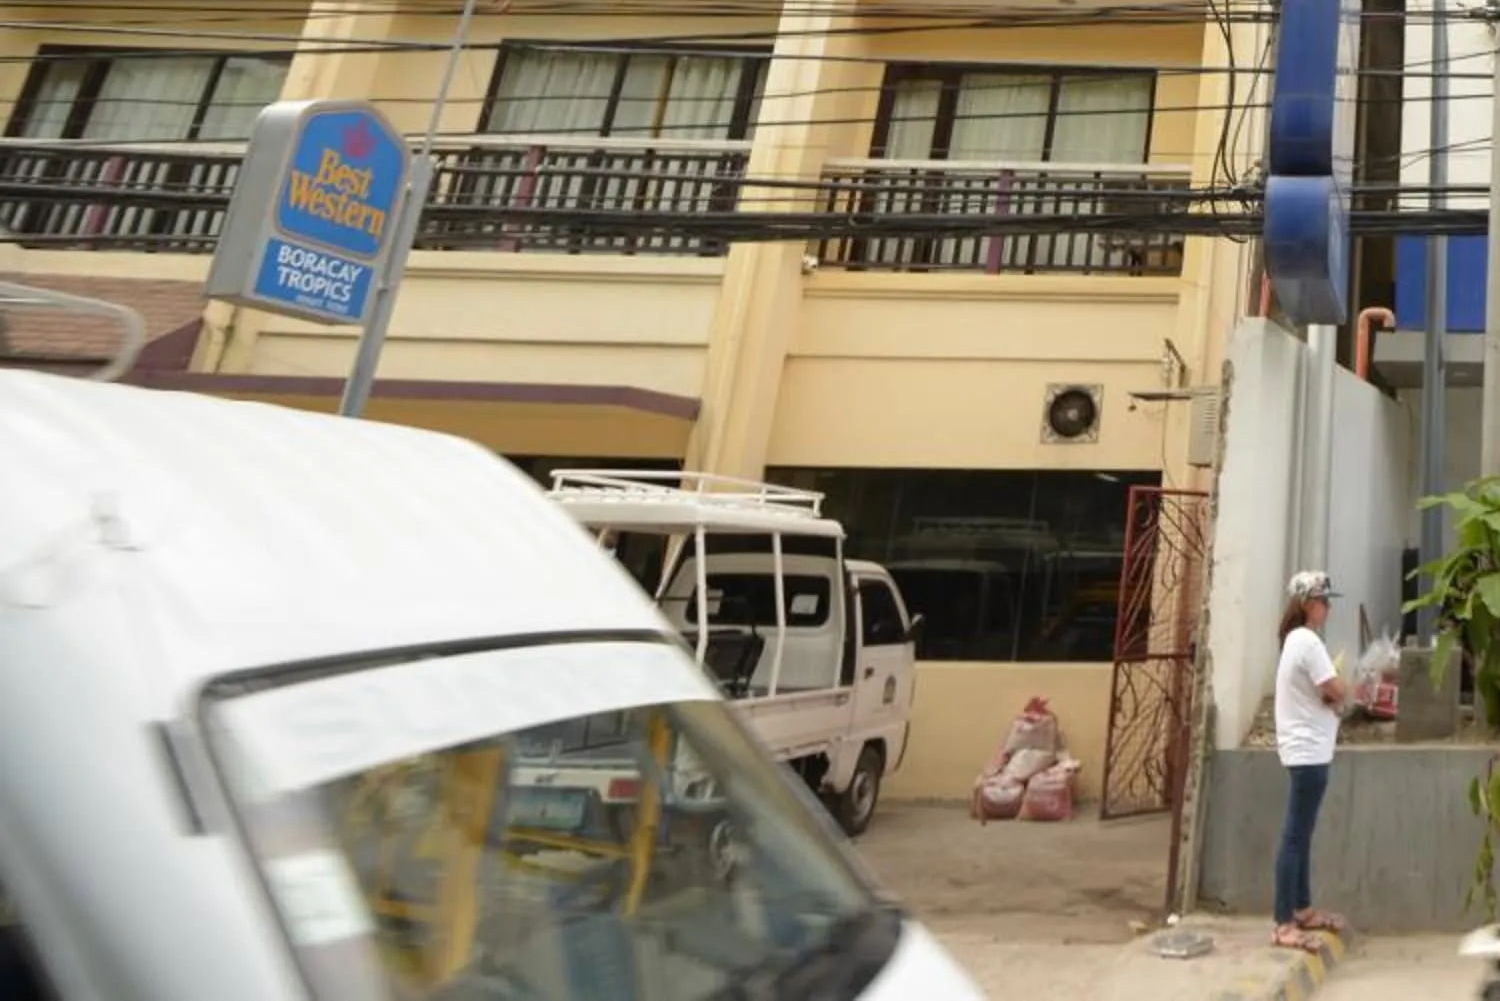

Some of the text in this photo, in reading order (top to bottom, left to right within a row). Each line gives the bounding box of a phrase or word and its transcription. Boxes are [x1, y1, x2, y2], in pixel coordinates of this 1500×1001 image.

[316, 148, 373, 198] Best
[289, 170, 386, 236] Western
[277, 245, 363, 283] BORACAY
[277, 266, 353, 302] TROPICS
